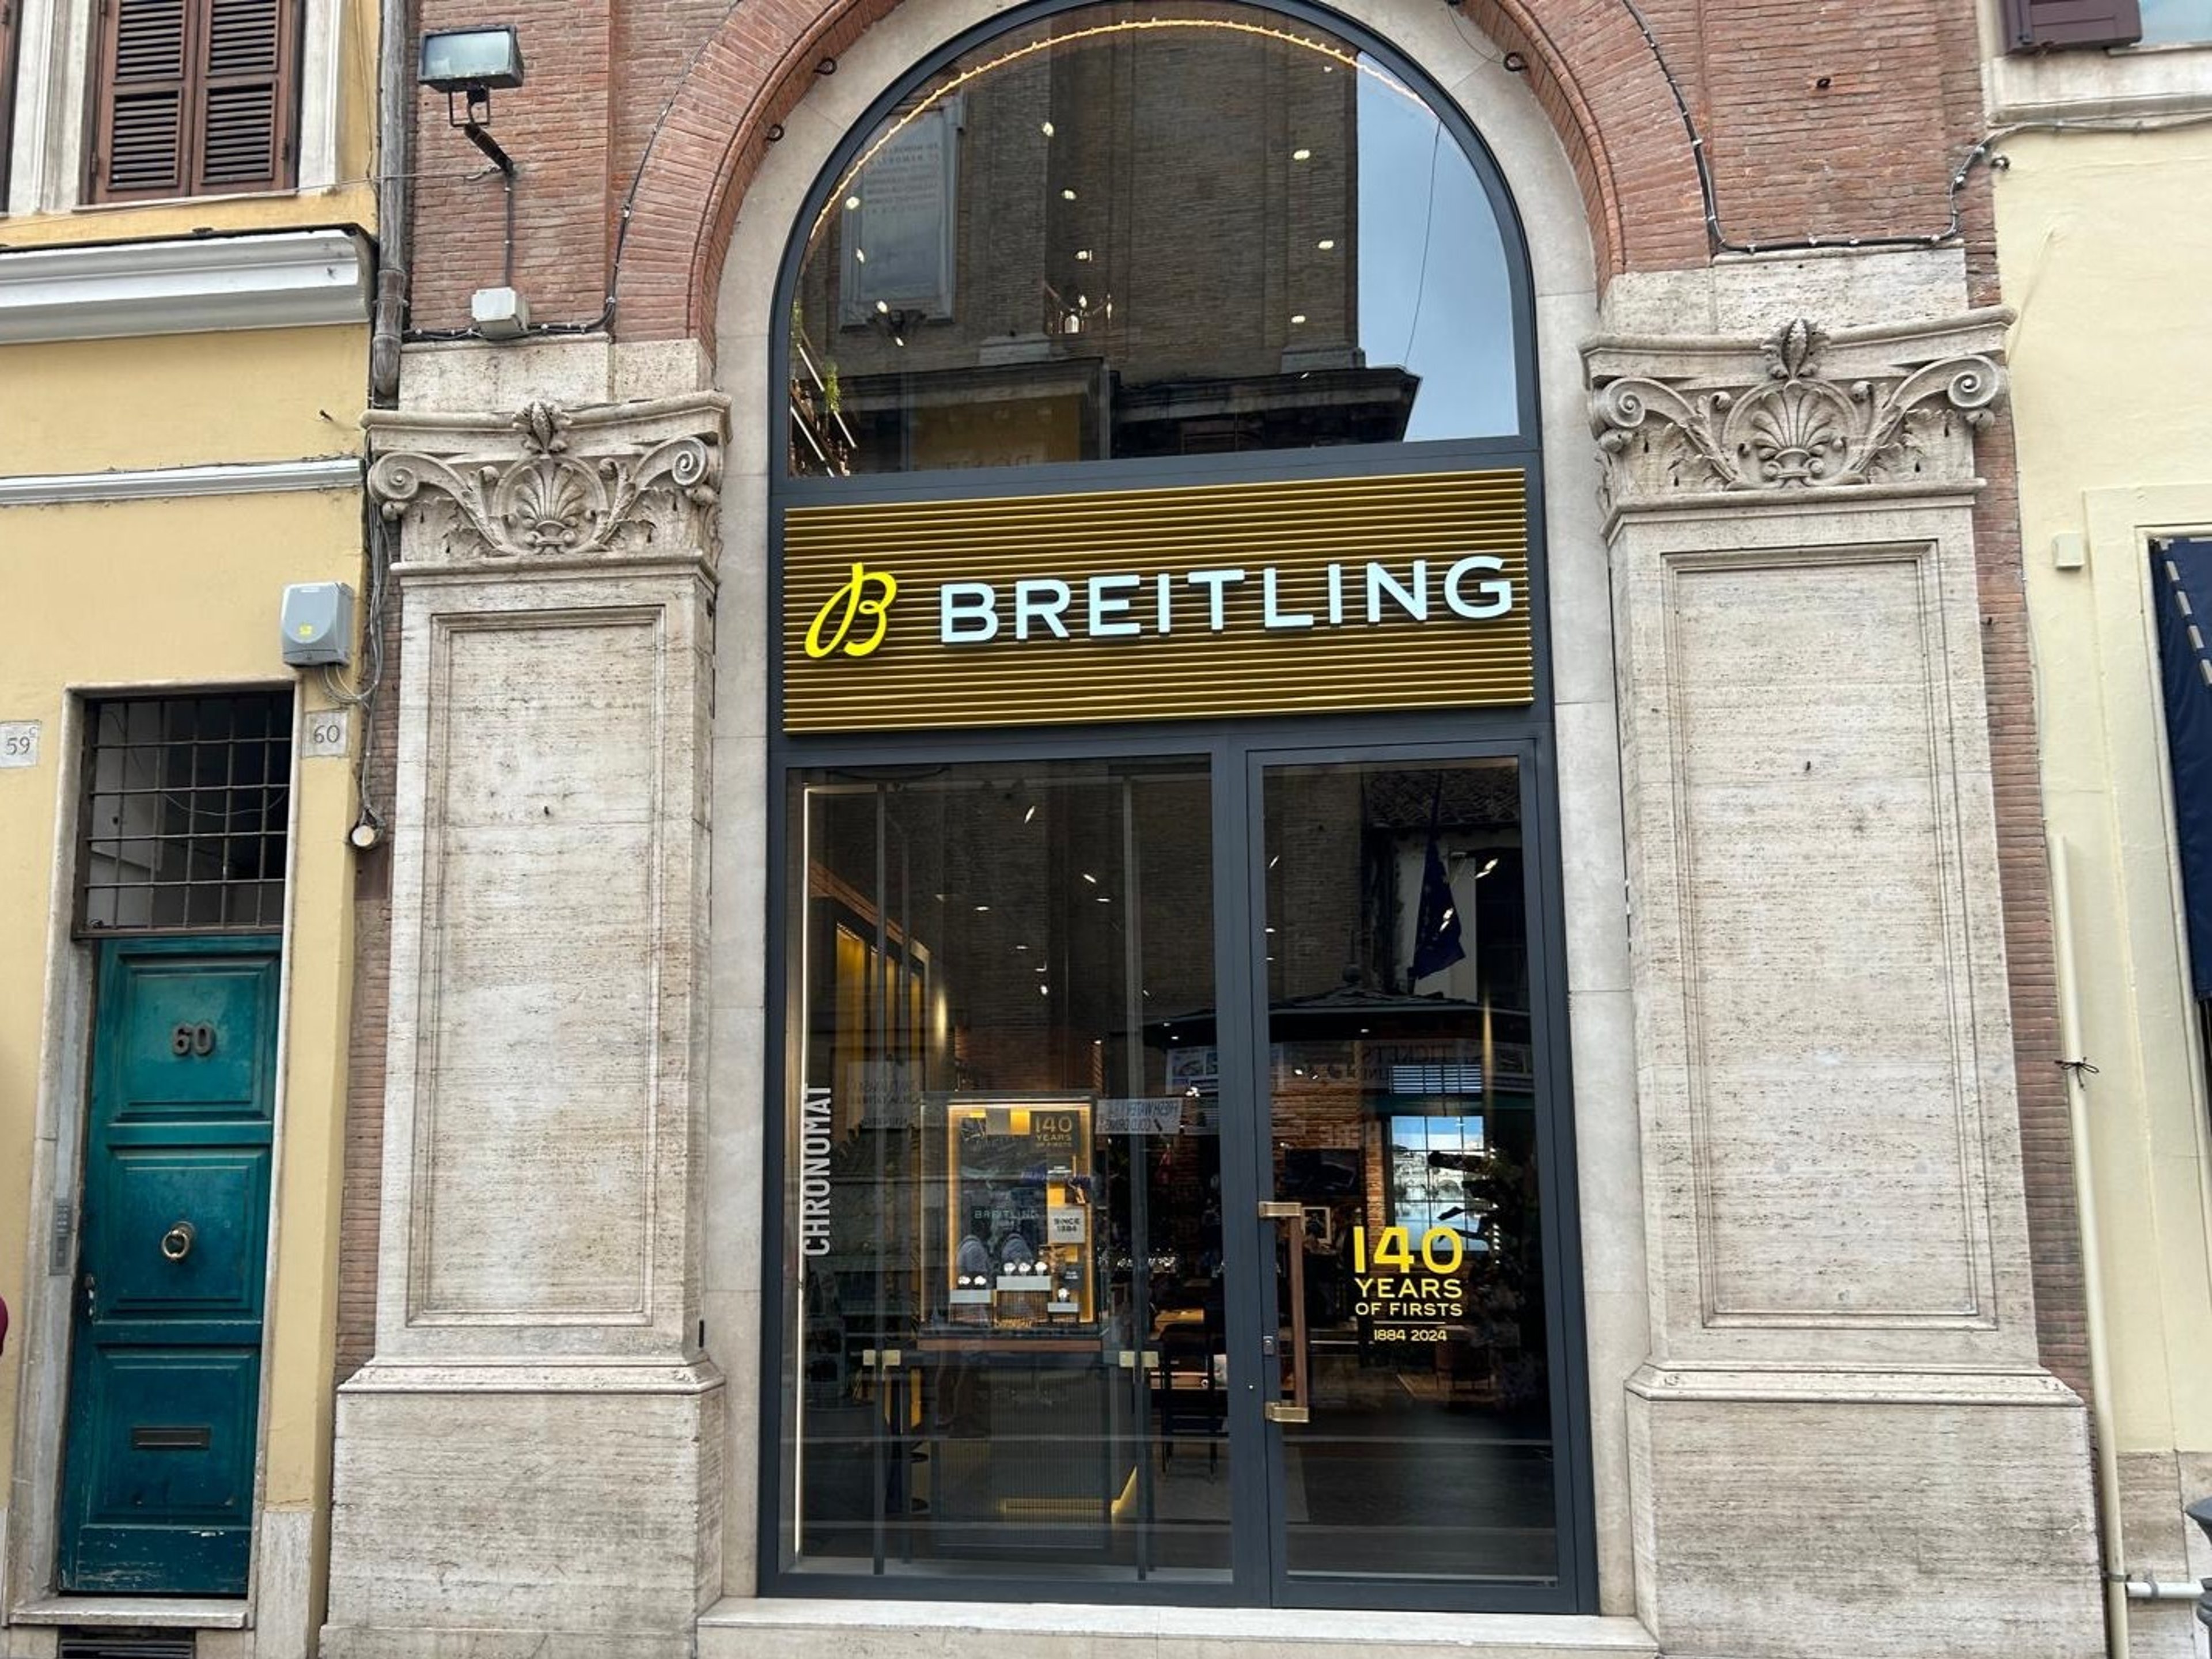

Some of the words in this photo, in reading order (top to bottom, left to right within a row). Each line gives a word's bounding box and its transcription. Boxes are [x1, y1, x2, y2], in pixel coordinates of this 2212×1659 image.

[940, 556, 1513, 646] BREITLING
[313, 724, 340, 744] 60
[173, 1021, 215, 1056] 60
[1036, 1115, 1072, 1132] 140
[803, 1083, 831, 1256] CHRONOMAT
[1353, 1226, 1463, 1274] 140
[1354, 1278, 1463, 1298] YEARS
[1355, 1302, 1382, 1316] OF
[1389, 1303, 1463, 1317] FIRSTS
[1374, 1330, 1406, 1342] 1884
[1411, 1330, 1447, 1342] 2024
